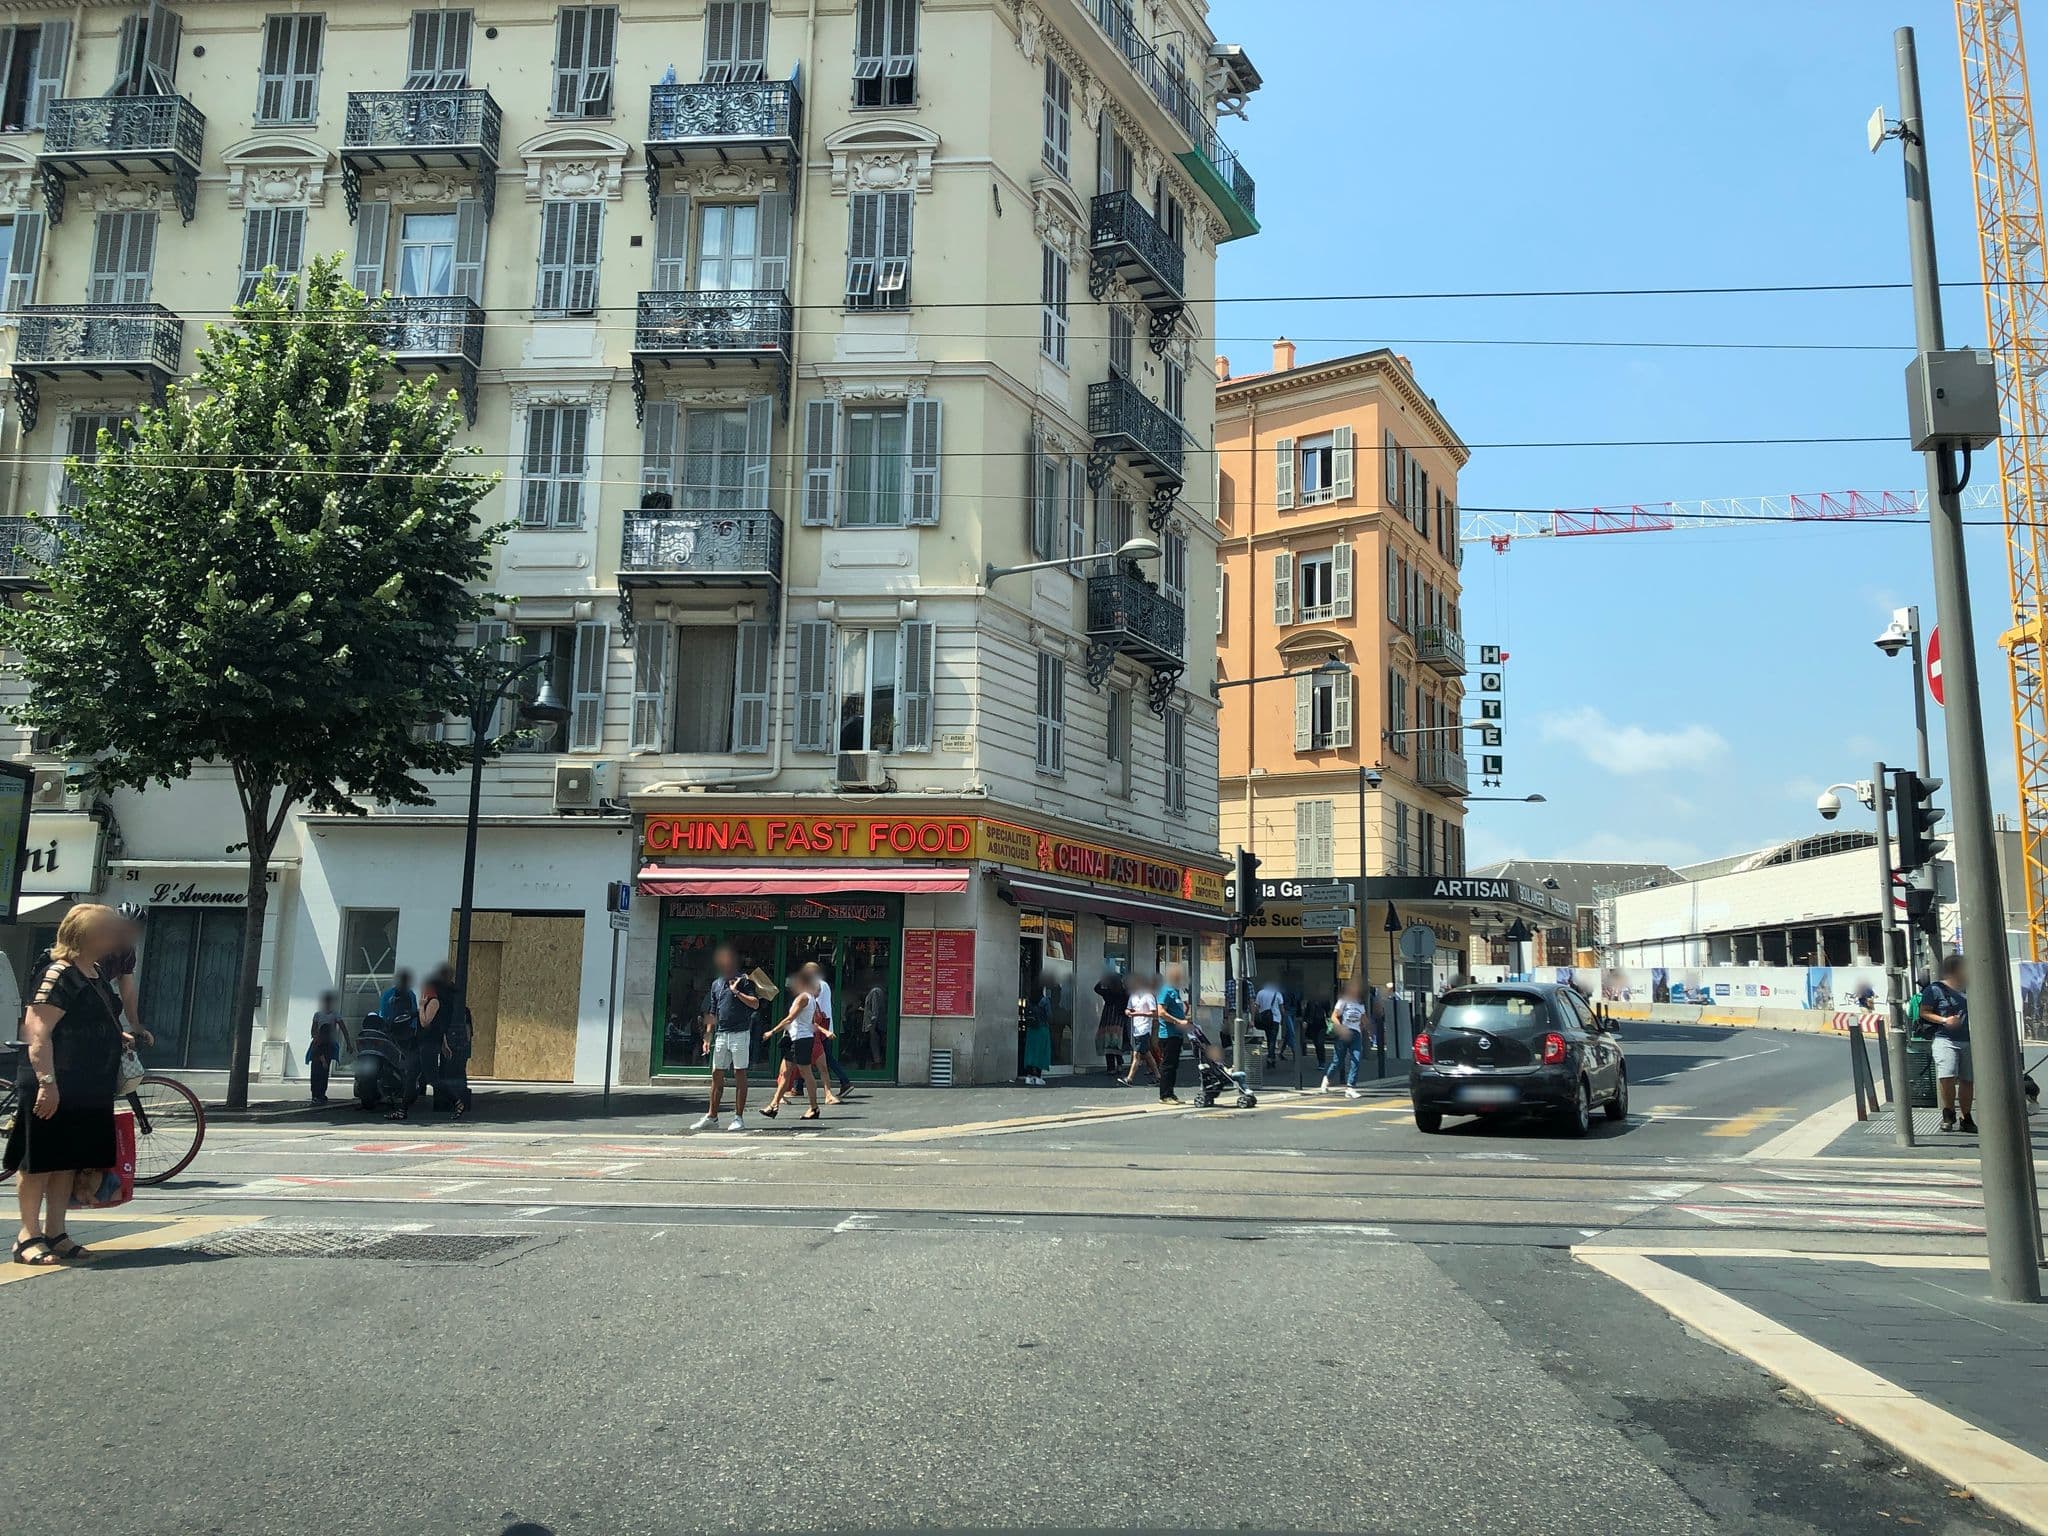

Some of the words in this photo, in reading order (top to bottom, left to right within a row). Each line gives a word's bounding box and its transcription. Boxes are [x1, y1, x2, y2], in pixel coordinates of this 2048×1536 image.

[1483, 647, 1499, 772] HOTEL
[647, 821, 755, 850] CHINA
[767, 822, 856, 851] FAST
[869, 823, 970, 851] FOOD
[23, 839, 59, 872] ni
[987, 841, 1029, 861] ASIATIQUES
[126, 870, 139, 881] 51
[265, 872, 278, 882] 51
[1056, 843, 1105, 877] CHINA
[1107, 854, 1142, 884] FAST
[1146, 862, 1180, 892] FOOD
[149, 883, 249, 904] L'Avenue
[1262, 884, 1276, 897] la
[1280, 881, 1312, 897] Ga
[1434, 879, 1509, 898] ARTISAN
[789, 903, 823, 918] SELF
[828, 903, 887, 919] SERVICE
